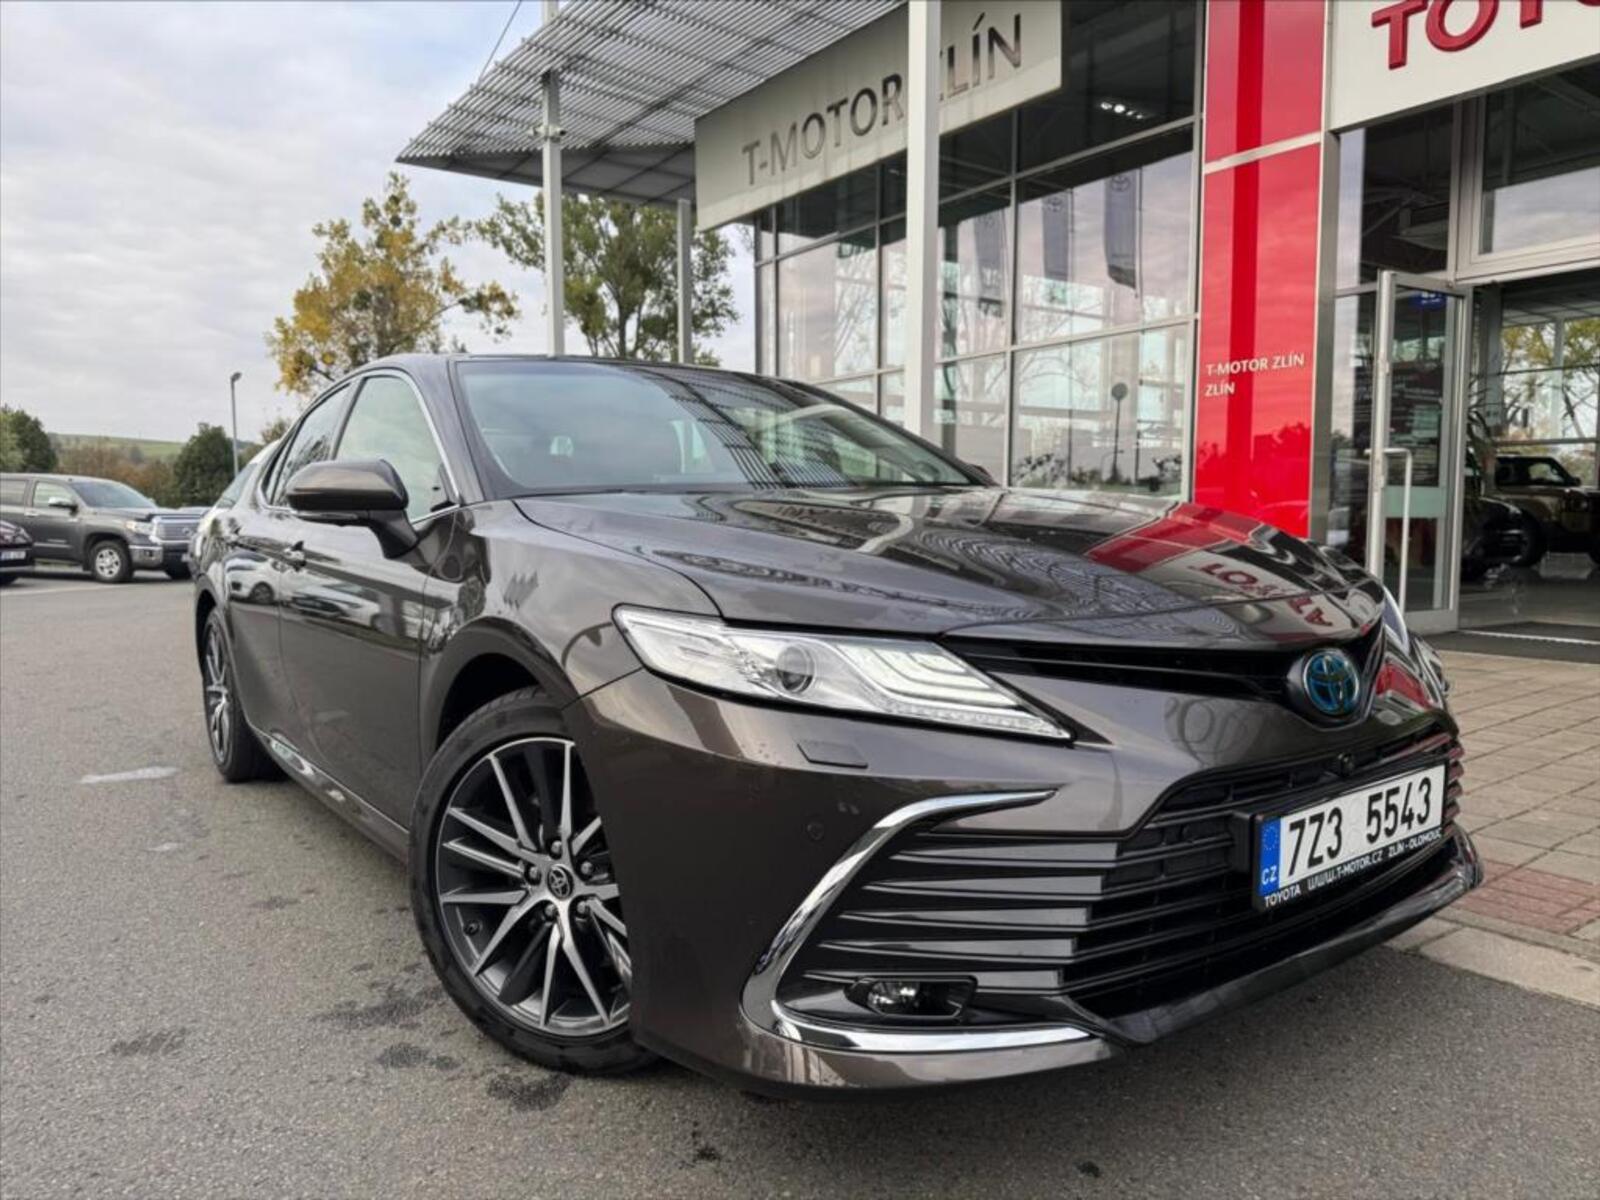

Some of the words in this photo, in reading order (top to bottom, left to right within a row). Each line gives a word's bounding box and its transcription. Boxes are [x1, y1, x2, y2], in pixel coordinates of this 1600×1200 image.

[1371, 0, 1600, 70] TO
[742, 73, 904, 186] T-MOTOR
[940, 12, 1021, 101] LÍN
[1206, 357, 1269, 377] T-MOTOR
[1272, 351, 1305, 370] ZLÍN
[1205, 380, 1236, 397] ZLÍN
[1288, 806, 1342, 877] 7Z3
[1366, 777, 1432, 844] 5543
[1261, 865, 1277, 886] CZ
[1264, 883, 1302, 908] TOYOTA
